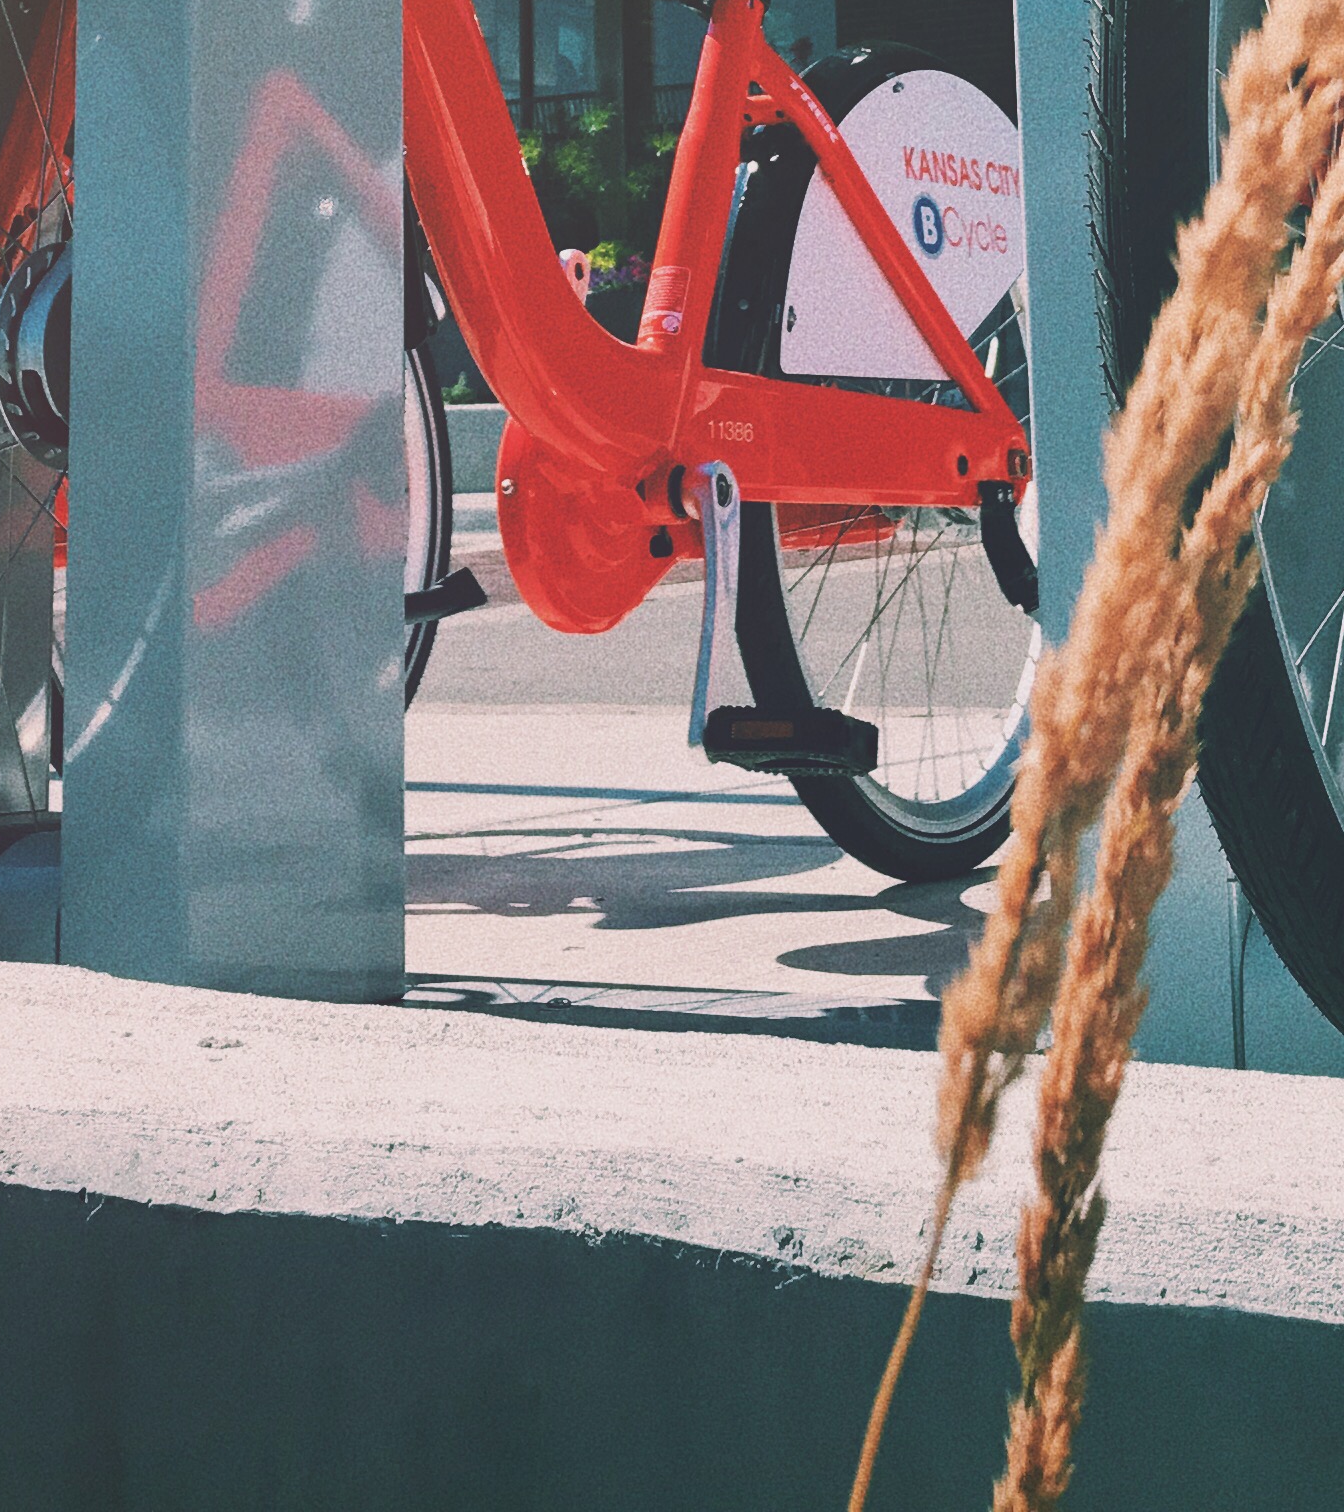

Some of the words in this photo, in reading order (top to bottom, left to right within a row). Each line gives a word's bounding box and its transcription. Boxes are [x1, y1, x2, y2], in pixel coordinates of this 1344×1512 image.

[903, 145, 982, 191] KANSAS
[985, 161, 1020, 199] CITY
[707, 419, 754, 443] 11386
